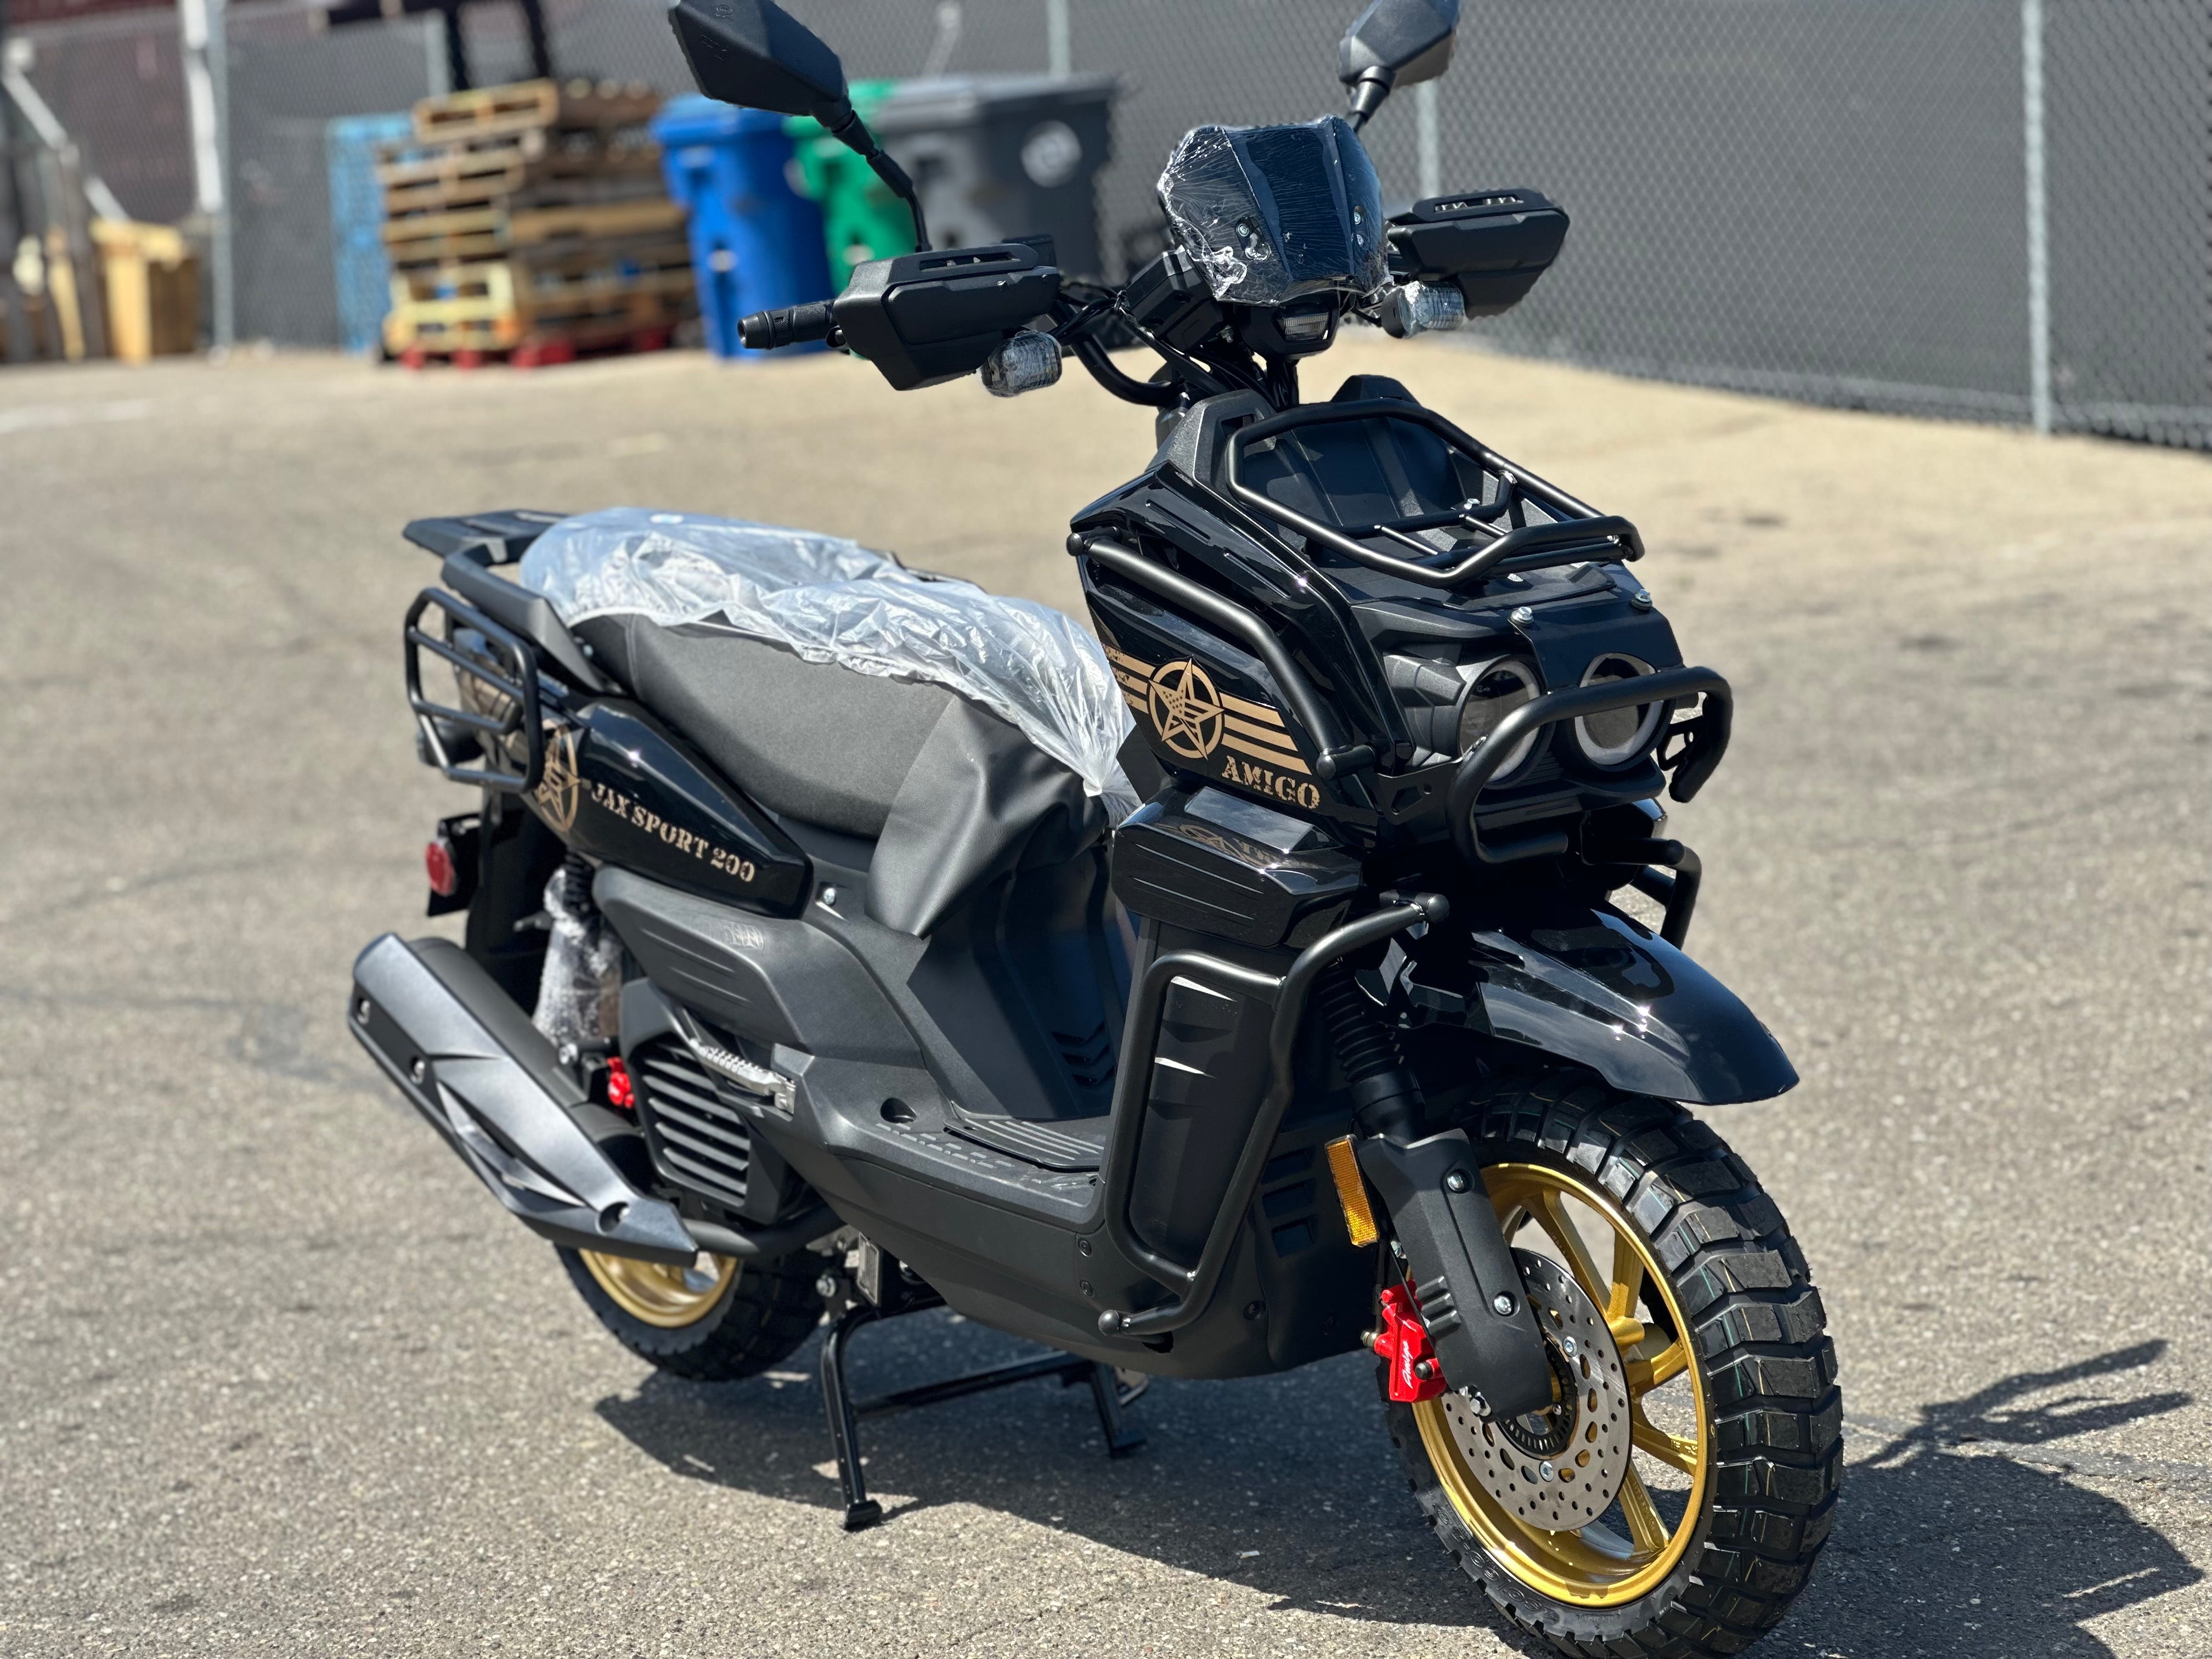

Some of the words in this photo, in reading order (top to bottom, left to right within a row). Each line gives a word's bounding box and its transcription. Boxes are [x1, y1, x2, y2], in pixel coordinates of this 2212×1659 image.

[1221, 755, 1321, 809] AMIGO
[591, 783, 631, 819] JAX
[631, 805, 709, 859] SPORT
[710, 848, 755, 882] 200
